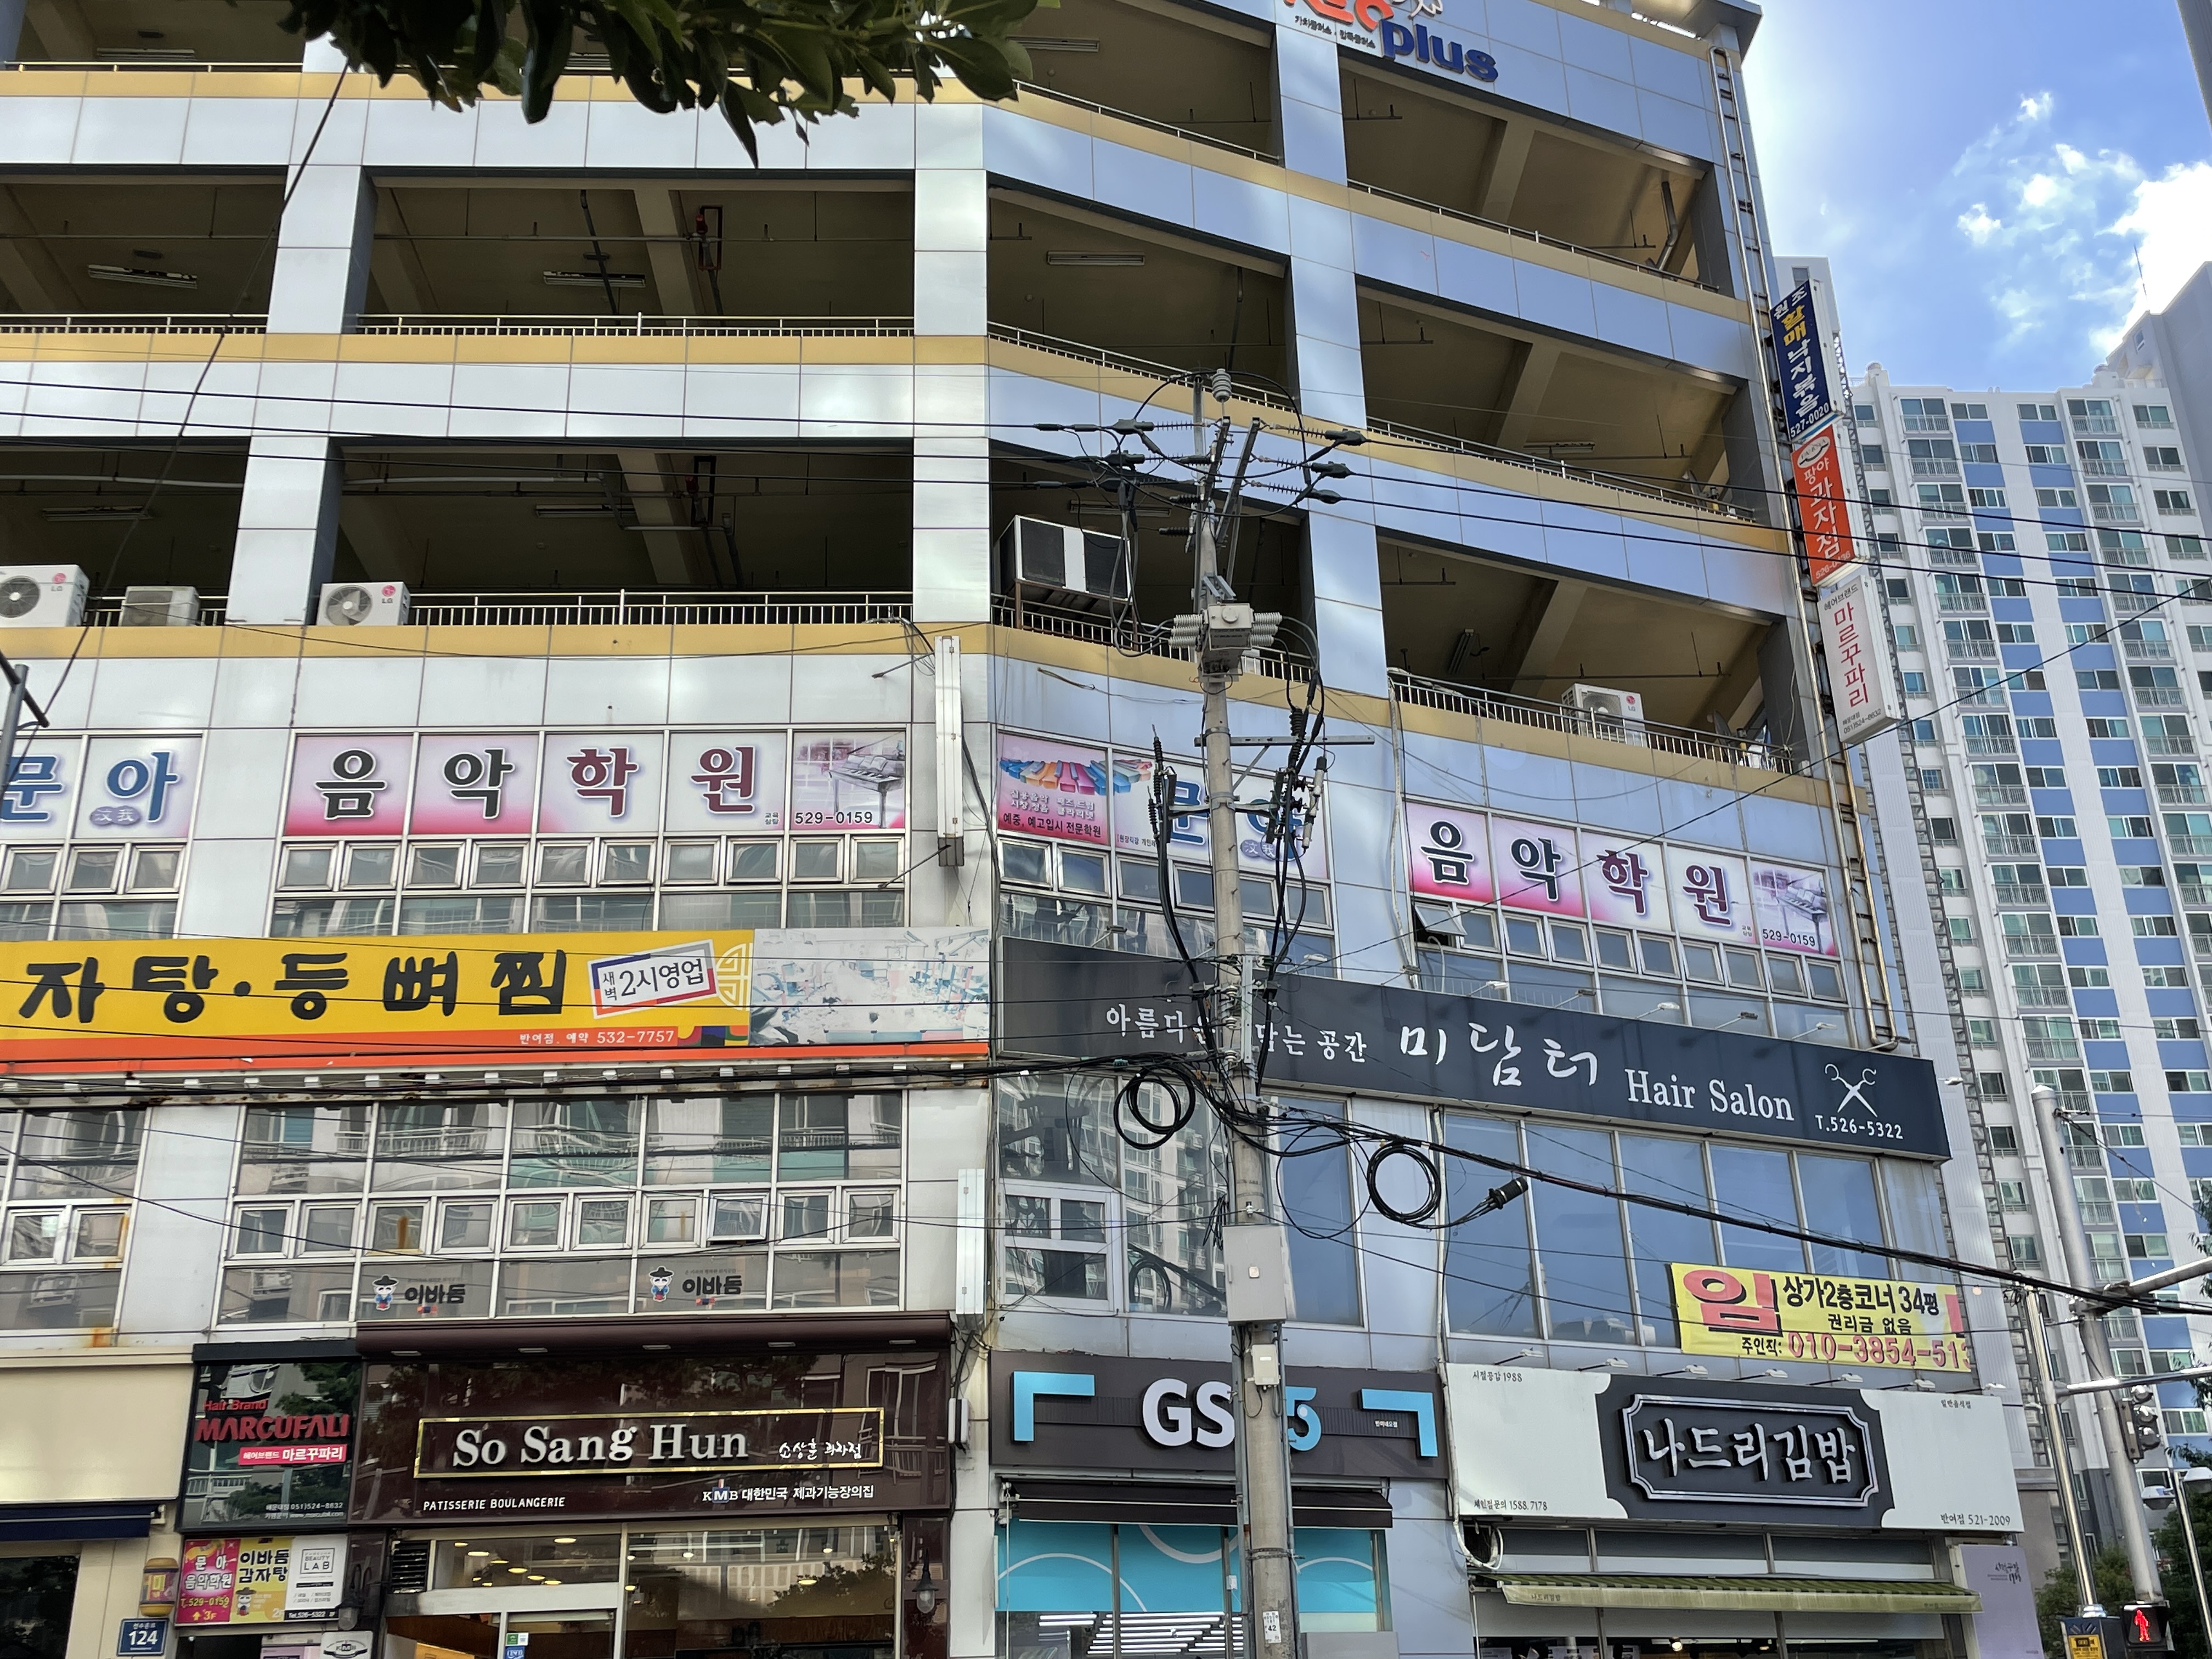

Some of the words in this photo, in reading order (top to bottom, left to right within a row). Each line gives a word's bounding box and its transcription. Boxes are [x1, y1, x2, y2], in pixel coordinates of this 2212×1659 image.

[1381, 19, 1498, 82] plus
[1774, 286, 1807, 320] 원조
[1781, 304, 1807, 346] 할매
[1787, 338, 1820, 417] 낙지볶음
[1790, 402, 1830, 438] 527-0020
[1804, 457, 1830, 485] 팡야
[1810, 476, 1841, 560] 과자점
[1824, 584, 1859, 611] 헤어브랜드
[1834, 601, 1870, 708] 마르꾸파리
[795, 811, 873, 823] 529-0159
[1003, 812, 1024, 827] 예중,
[1028, 816, 1063, 832] 예고입시
[1066, 822, 1101, 838] 전문학원
[1420, 819, 1732, 927] 음악학원
[1763, 928, 1815, 947] 529-0159
[603, 972, 617, 1001] 새벽
[619, 958, 704, 997] 2시영업
[566, 1032, 589, 1043] 예약
[597, 1030, 674, 1044] 532-7757
[1317, 1030, 1367, 1063] 공간
[1624, 1068, 1696, 1110] Hair
[1708, 1079, 1795, 1122] Salon
[1815, 1114, 1904, 1141] T.526-5322
[1900, 1285, 1939, 1316] 34평
[1827, 1312, 1874, 1334] 권리금
[1882, 1317, 1912, 1335] 없음
[1503, 1372, 1522, 1382] 1988
[204, 1400, 227, 1411] Hair
[230, 1400, 268, 1410] Brand
[1142, 1378, 1322, 1452] GS5
[194, 1414, 350, 1442] MARCUFALI
[243, 1451, 280, 1460] 헤어브랜드
[282, 1446, 343, 1461] 마르꾸파리
[452, 1427, 506, 1468] So
[520, 1424, 638, 1464] Sang
[648, 1423, 749, 1462] Hun
[779, 1438, 818, 1460] 소상훈
[825, 1441, 862, 1459] 과자점
[1643, 1417, 1856, 1484] 나드리김밥
[423, 1498, 487, 1511] PATISSERIE
[490, 1495, 566, 1509] BOULANGERIE
[742, 1485, 788, 1502] 대한민국
[793, 1485, 874, 1500] 제과기능장의집
[1940, 1513, 1965, 1525] 반여점
[1968, 1514, 2011, 1526] 521-2009
[239, 1567, 288, 1583] 감자탕
[304, 1561, 330, 1571] LAB
[185, 1573, 233, 1590] 음악학원
[203, 1610, 217, 1621] 3F
[129, 1630, 158, 1646] 124
